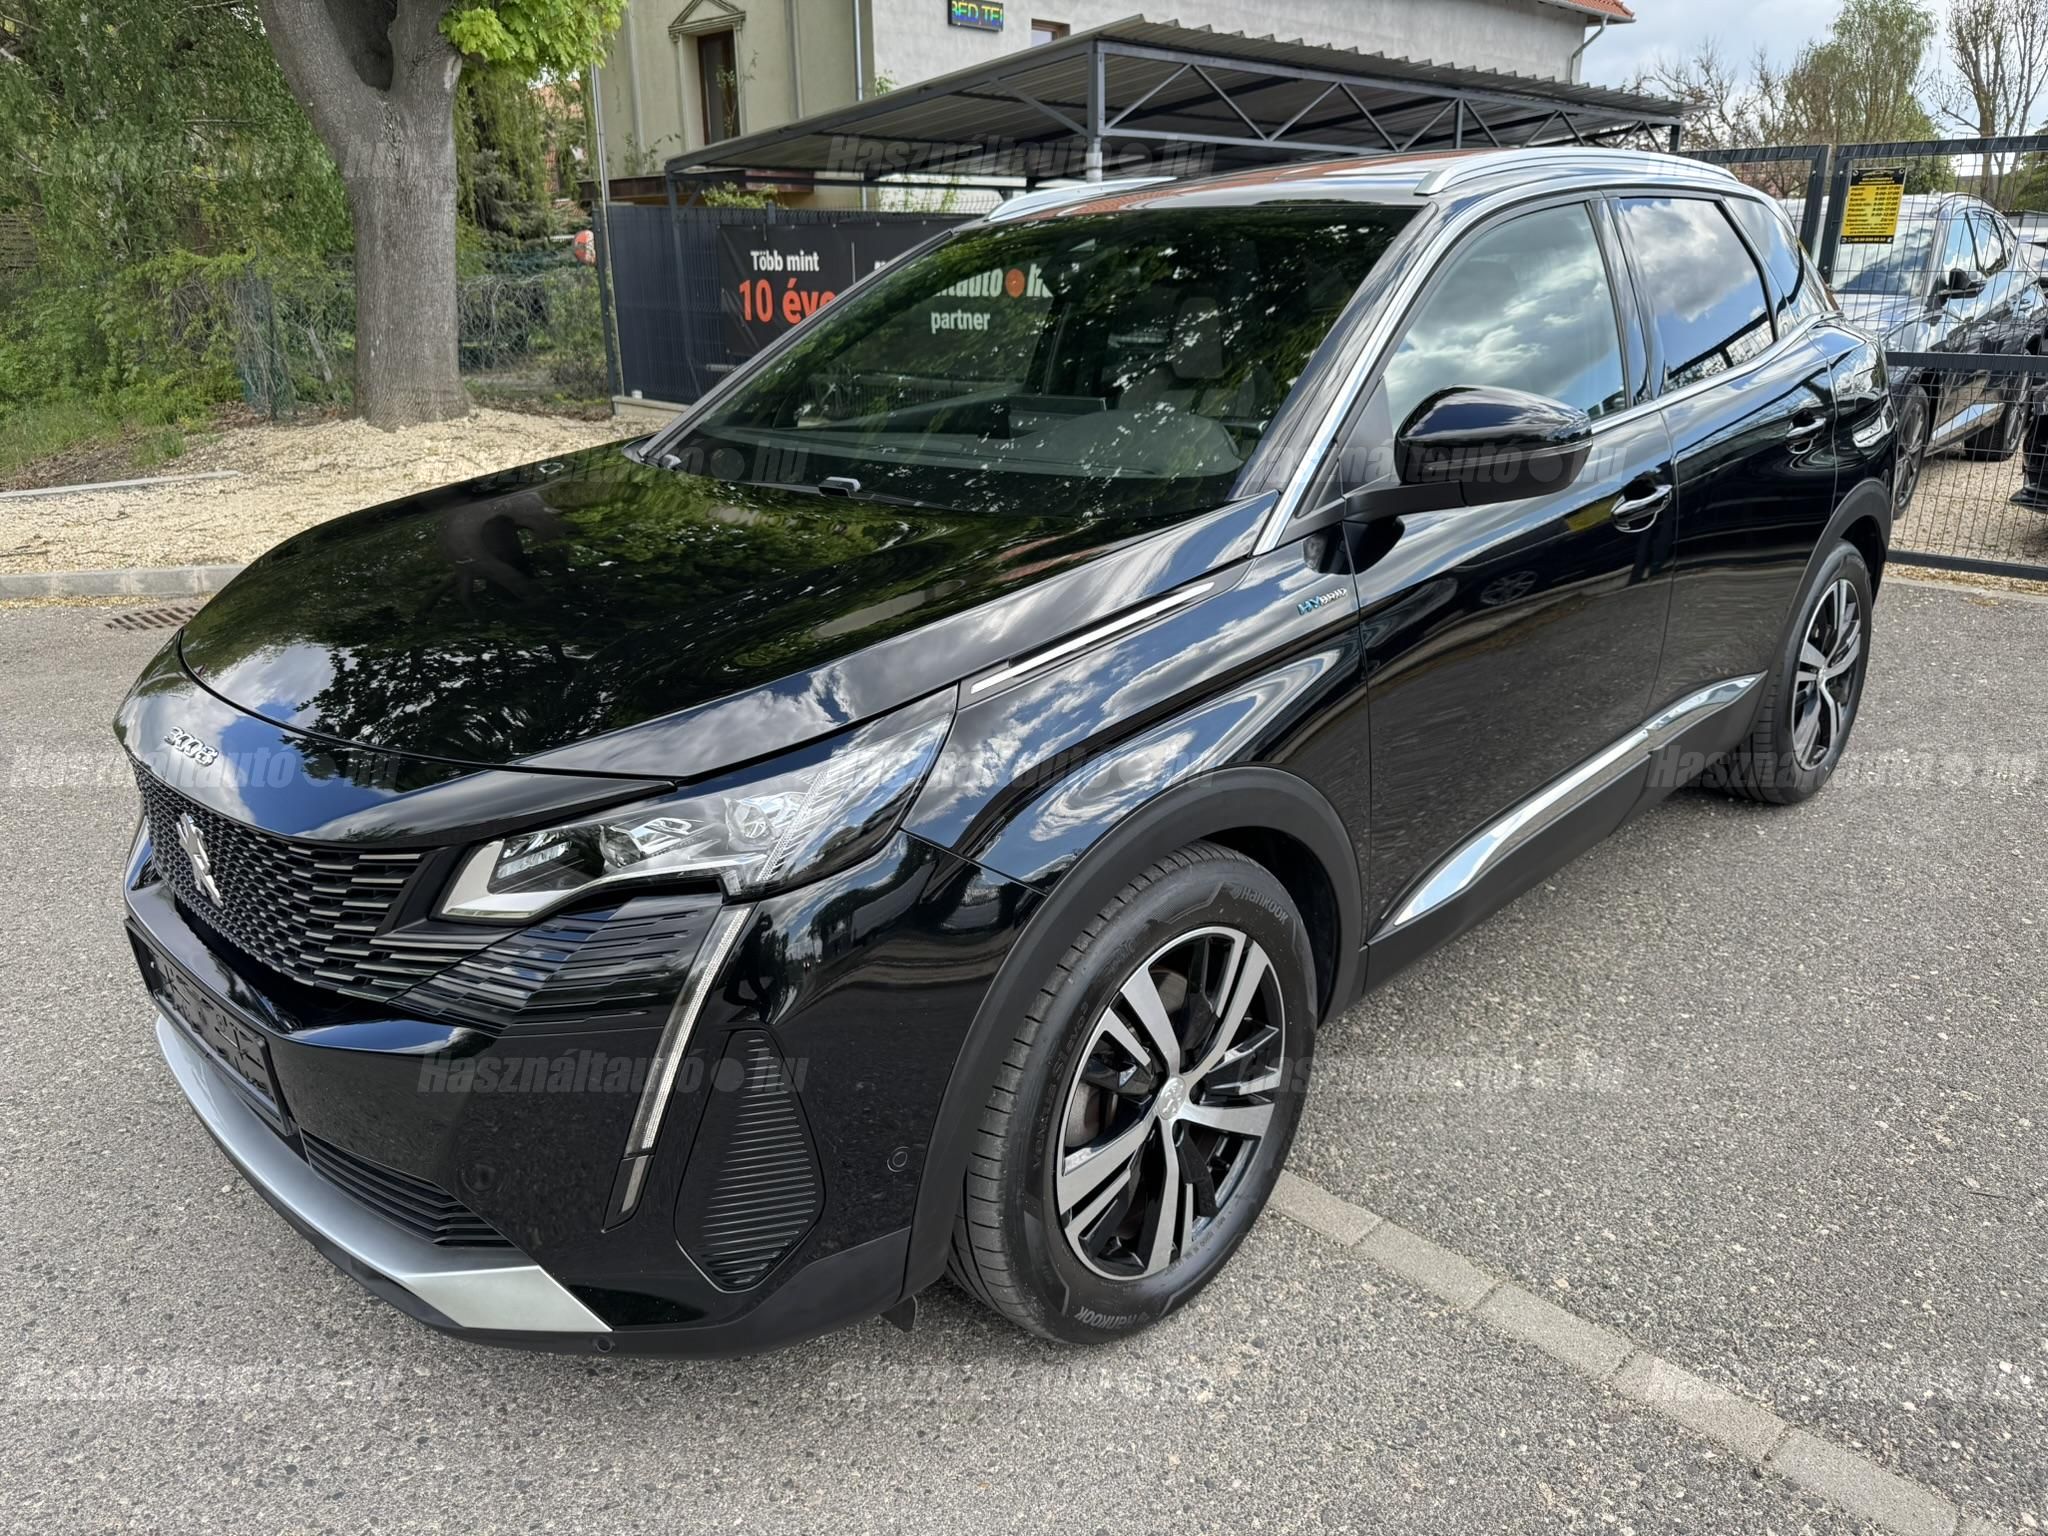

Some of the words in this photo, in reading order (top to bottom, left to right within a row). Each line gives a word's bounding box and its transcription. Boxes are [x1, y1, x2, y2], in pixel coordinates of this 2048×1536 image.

[750, 249, 783, 271] Több
[786, 249, 820, 272] mint
[739, 279, 773, 323] 10
[931, 309, 991, 334] partner
[164, 726, 219, 767] 3008
